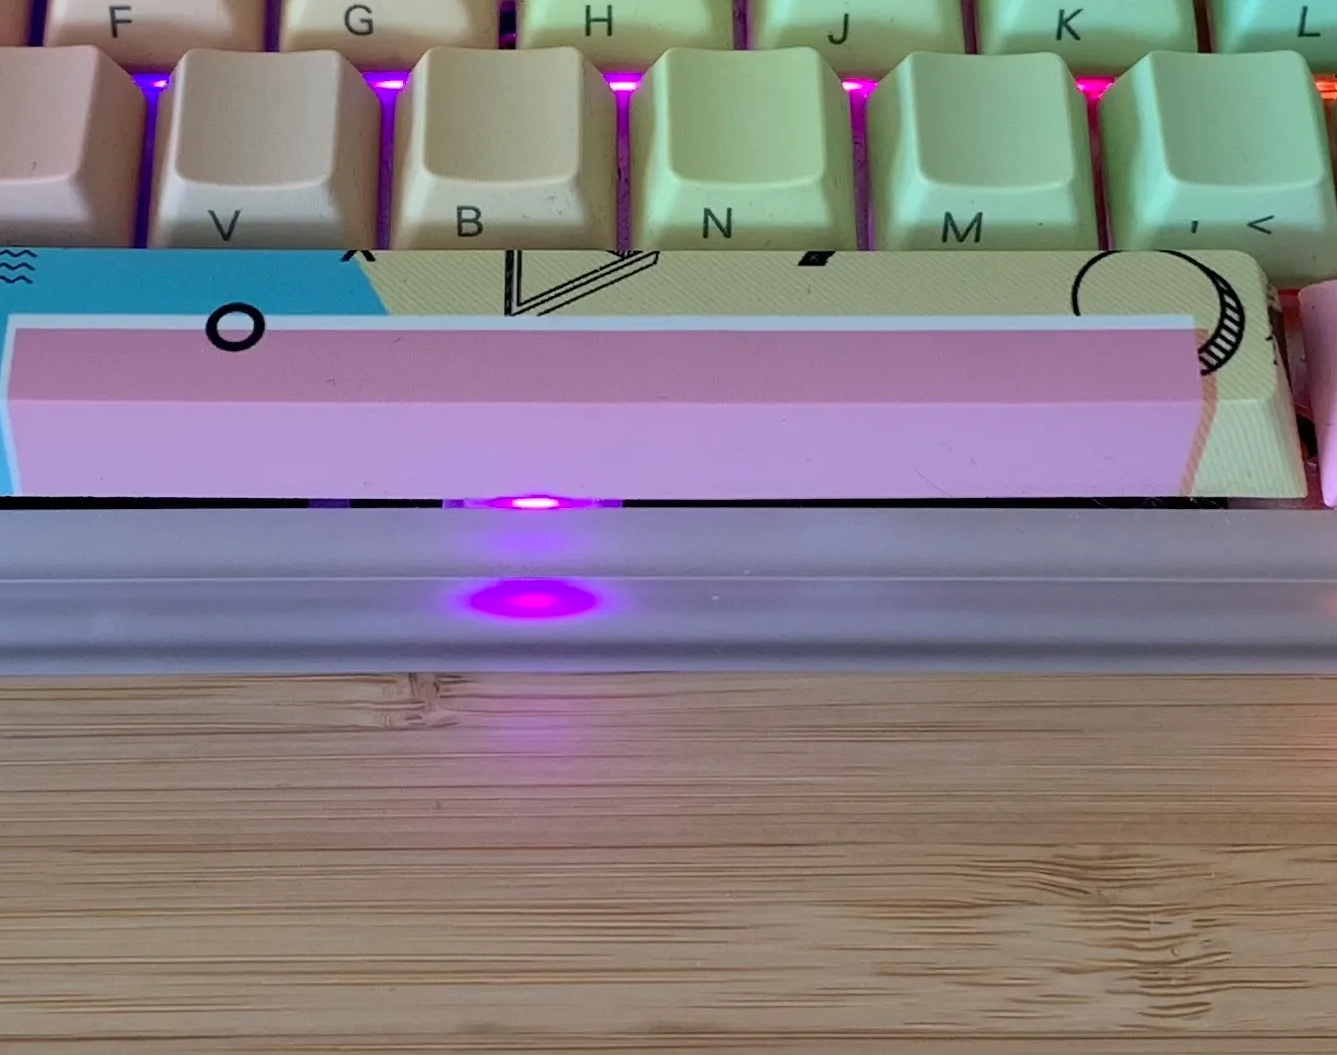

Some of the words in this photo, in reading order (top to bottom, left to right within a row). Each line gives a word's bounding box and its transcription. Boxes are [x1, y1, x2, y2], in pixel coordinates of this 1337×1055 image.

[108, 5, 133, 39] F
[343, 3, 374, 36] G
[585, 4, 613, 37] H
[827, 12, 850, 45] J
[1056, 8, 1084, 41] K
[1297, 5, 1321, 38] L
[207, 209, 242, 242] V
[456, 205, 483, 238] B
[702, 207, 733, 239] N
[941, 211, 984, 244] M
[1247, 214, 1275, 235] <
